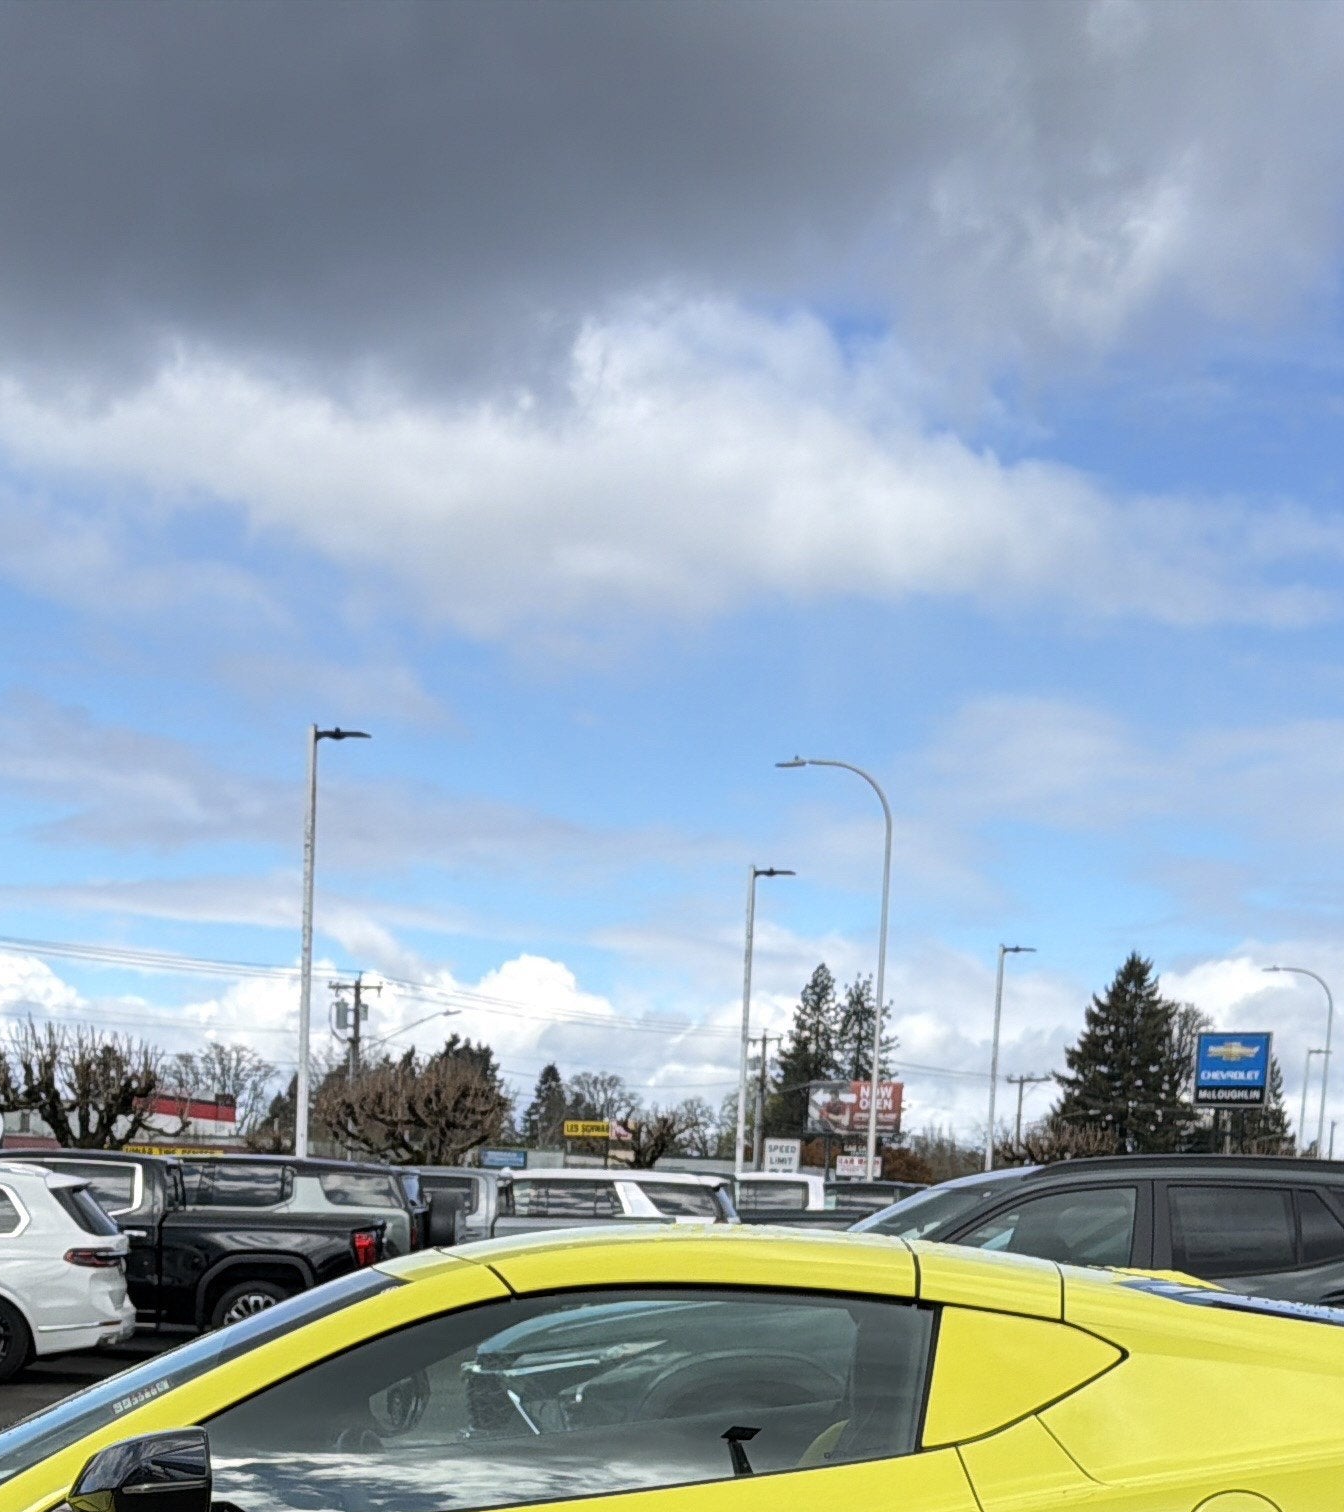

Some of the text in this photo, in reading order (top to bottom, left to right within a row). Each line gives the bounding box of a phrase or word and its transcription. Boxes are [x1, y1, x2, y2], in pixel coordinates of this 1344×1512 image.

[1200, 1070, 1260, 1080] CHEVROLET
[859, 1098, 893, 1110] OEN
[768, 1144, 797, 1153] SPEED
[769, 1157, 793, 1165] LIMIT
